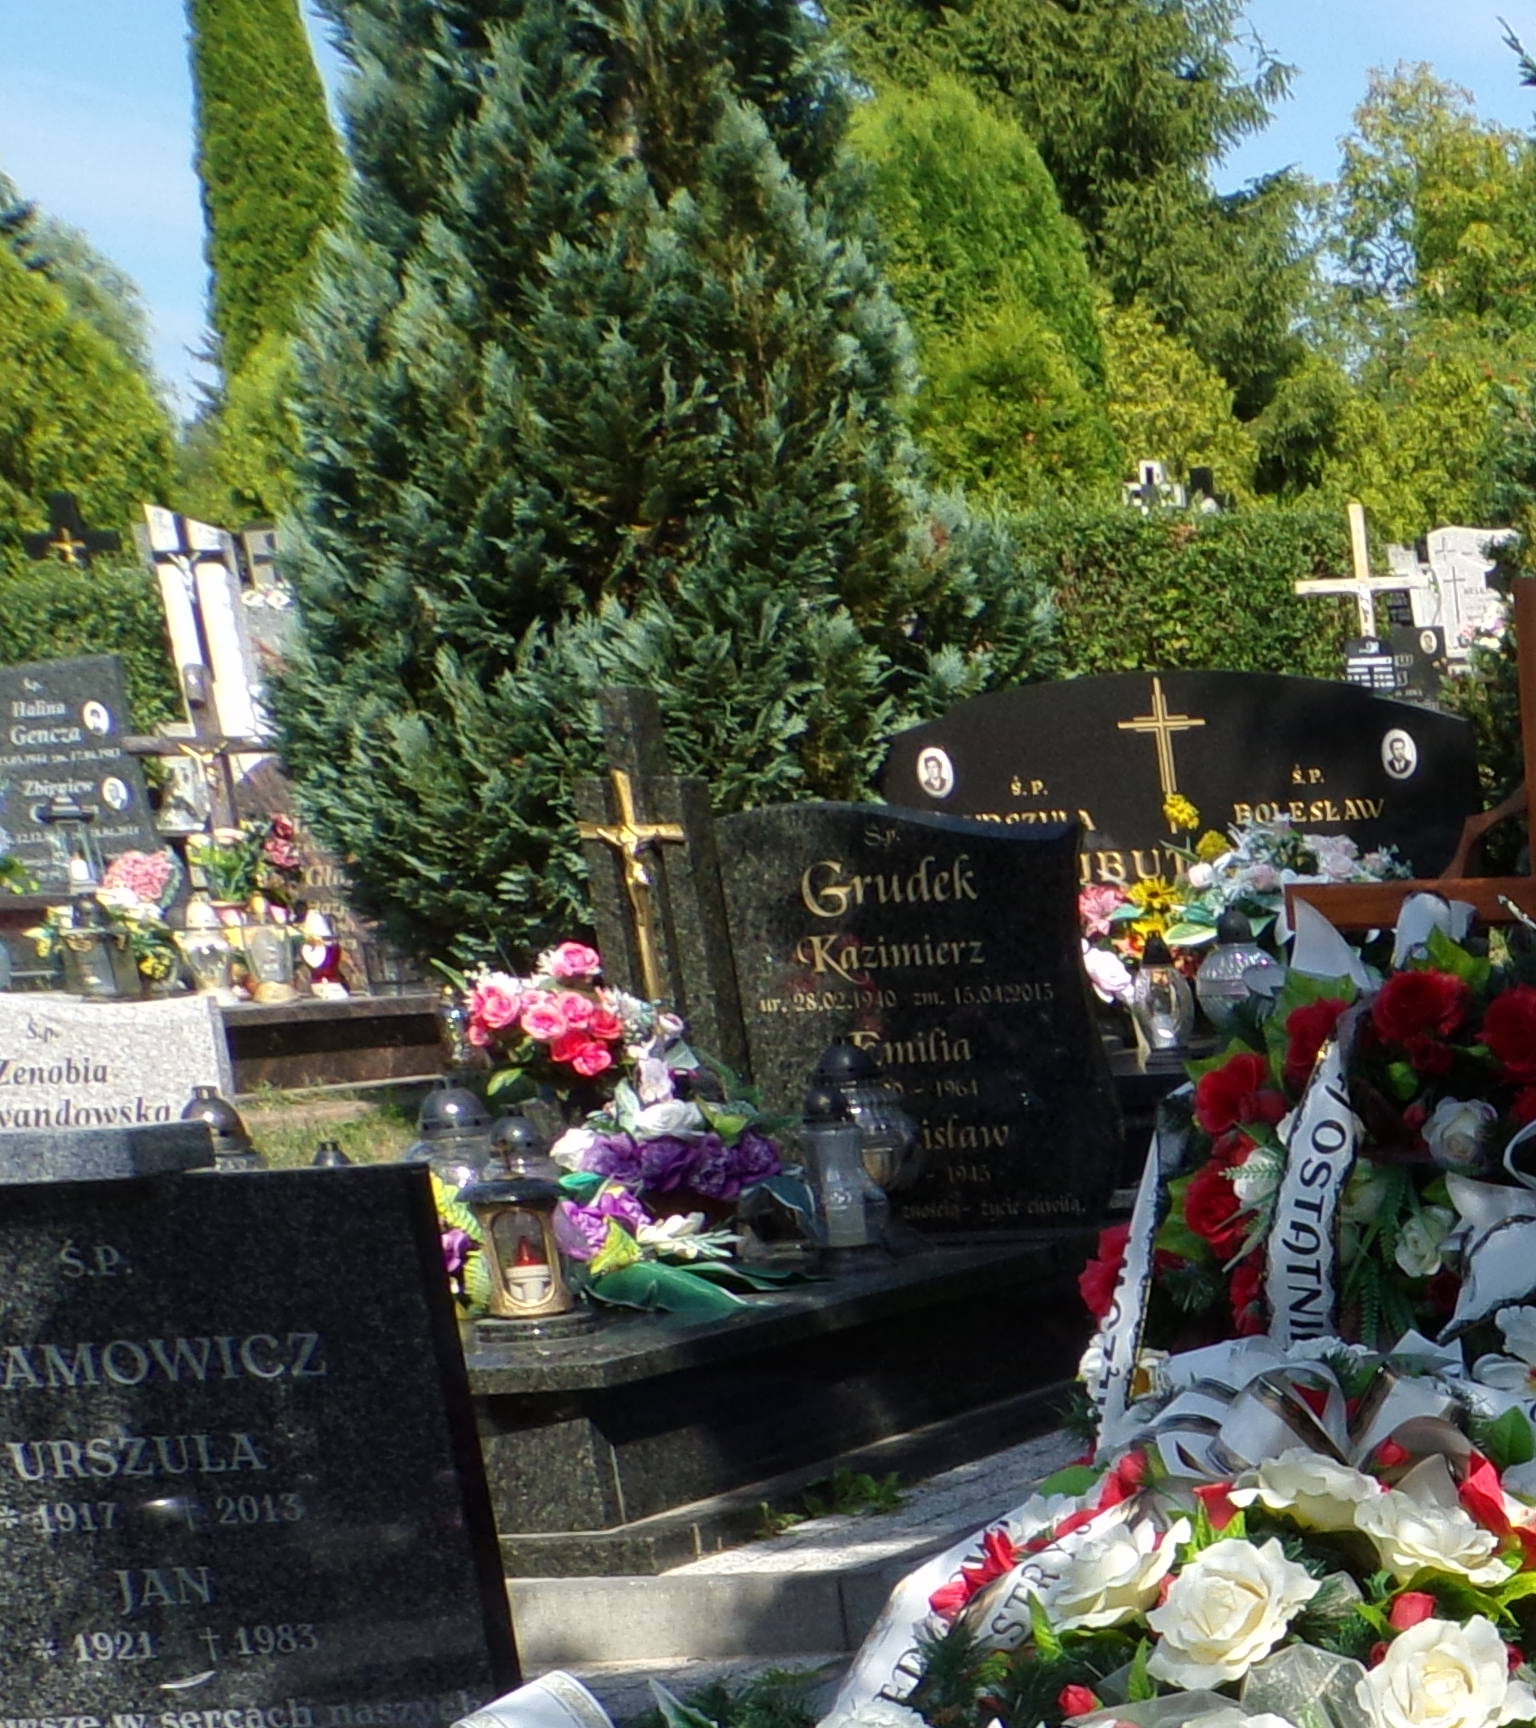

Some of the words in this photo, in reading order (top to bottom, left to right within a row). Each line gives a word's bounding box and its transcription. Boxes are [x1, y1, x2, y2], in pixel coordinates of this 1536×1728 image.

[801, 854, 978, 918] Grudek
[795, 932, 986, 986] Kazimierz
[847, 1026, 974, 1068] Emilia
[0, 1056, 108, 1086] Zenobia
[5, 1431, 268, 1482] URSZULA
[35, 1502, 118, 1534] 1917
[216, 1494, 304, 1525] 2013
[114, 1566, 213, 1616] JAN
[73, 1631, 158, 1664] 1921
[235, 1623, 320, 1656] 1983
